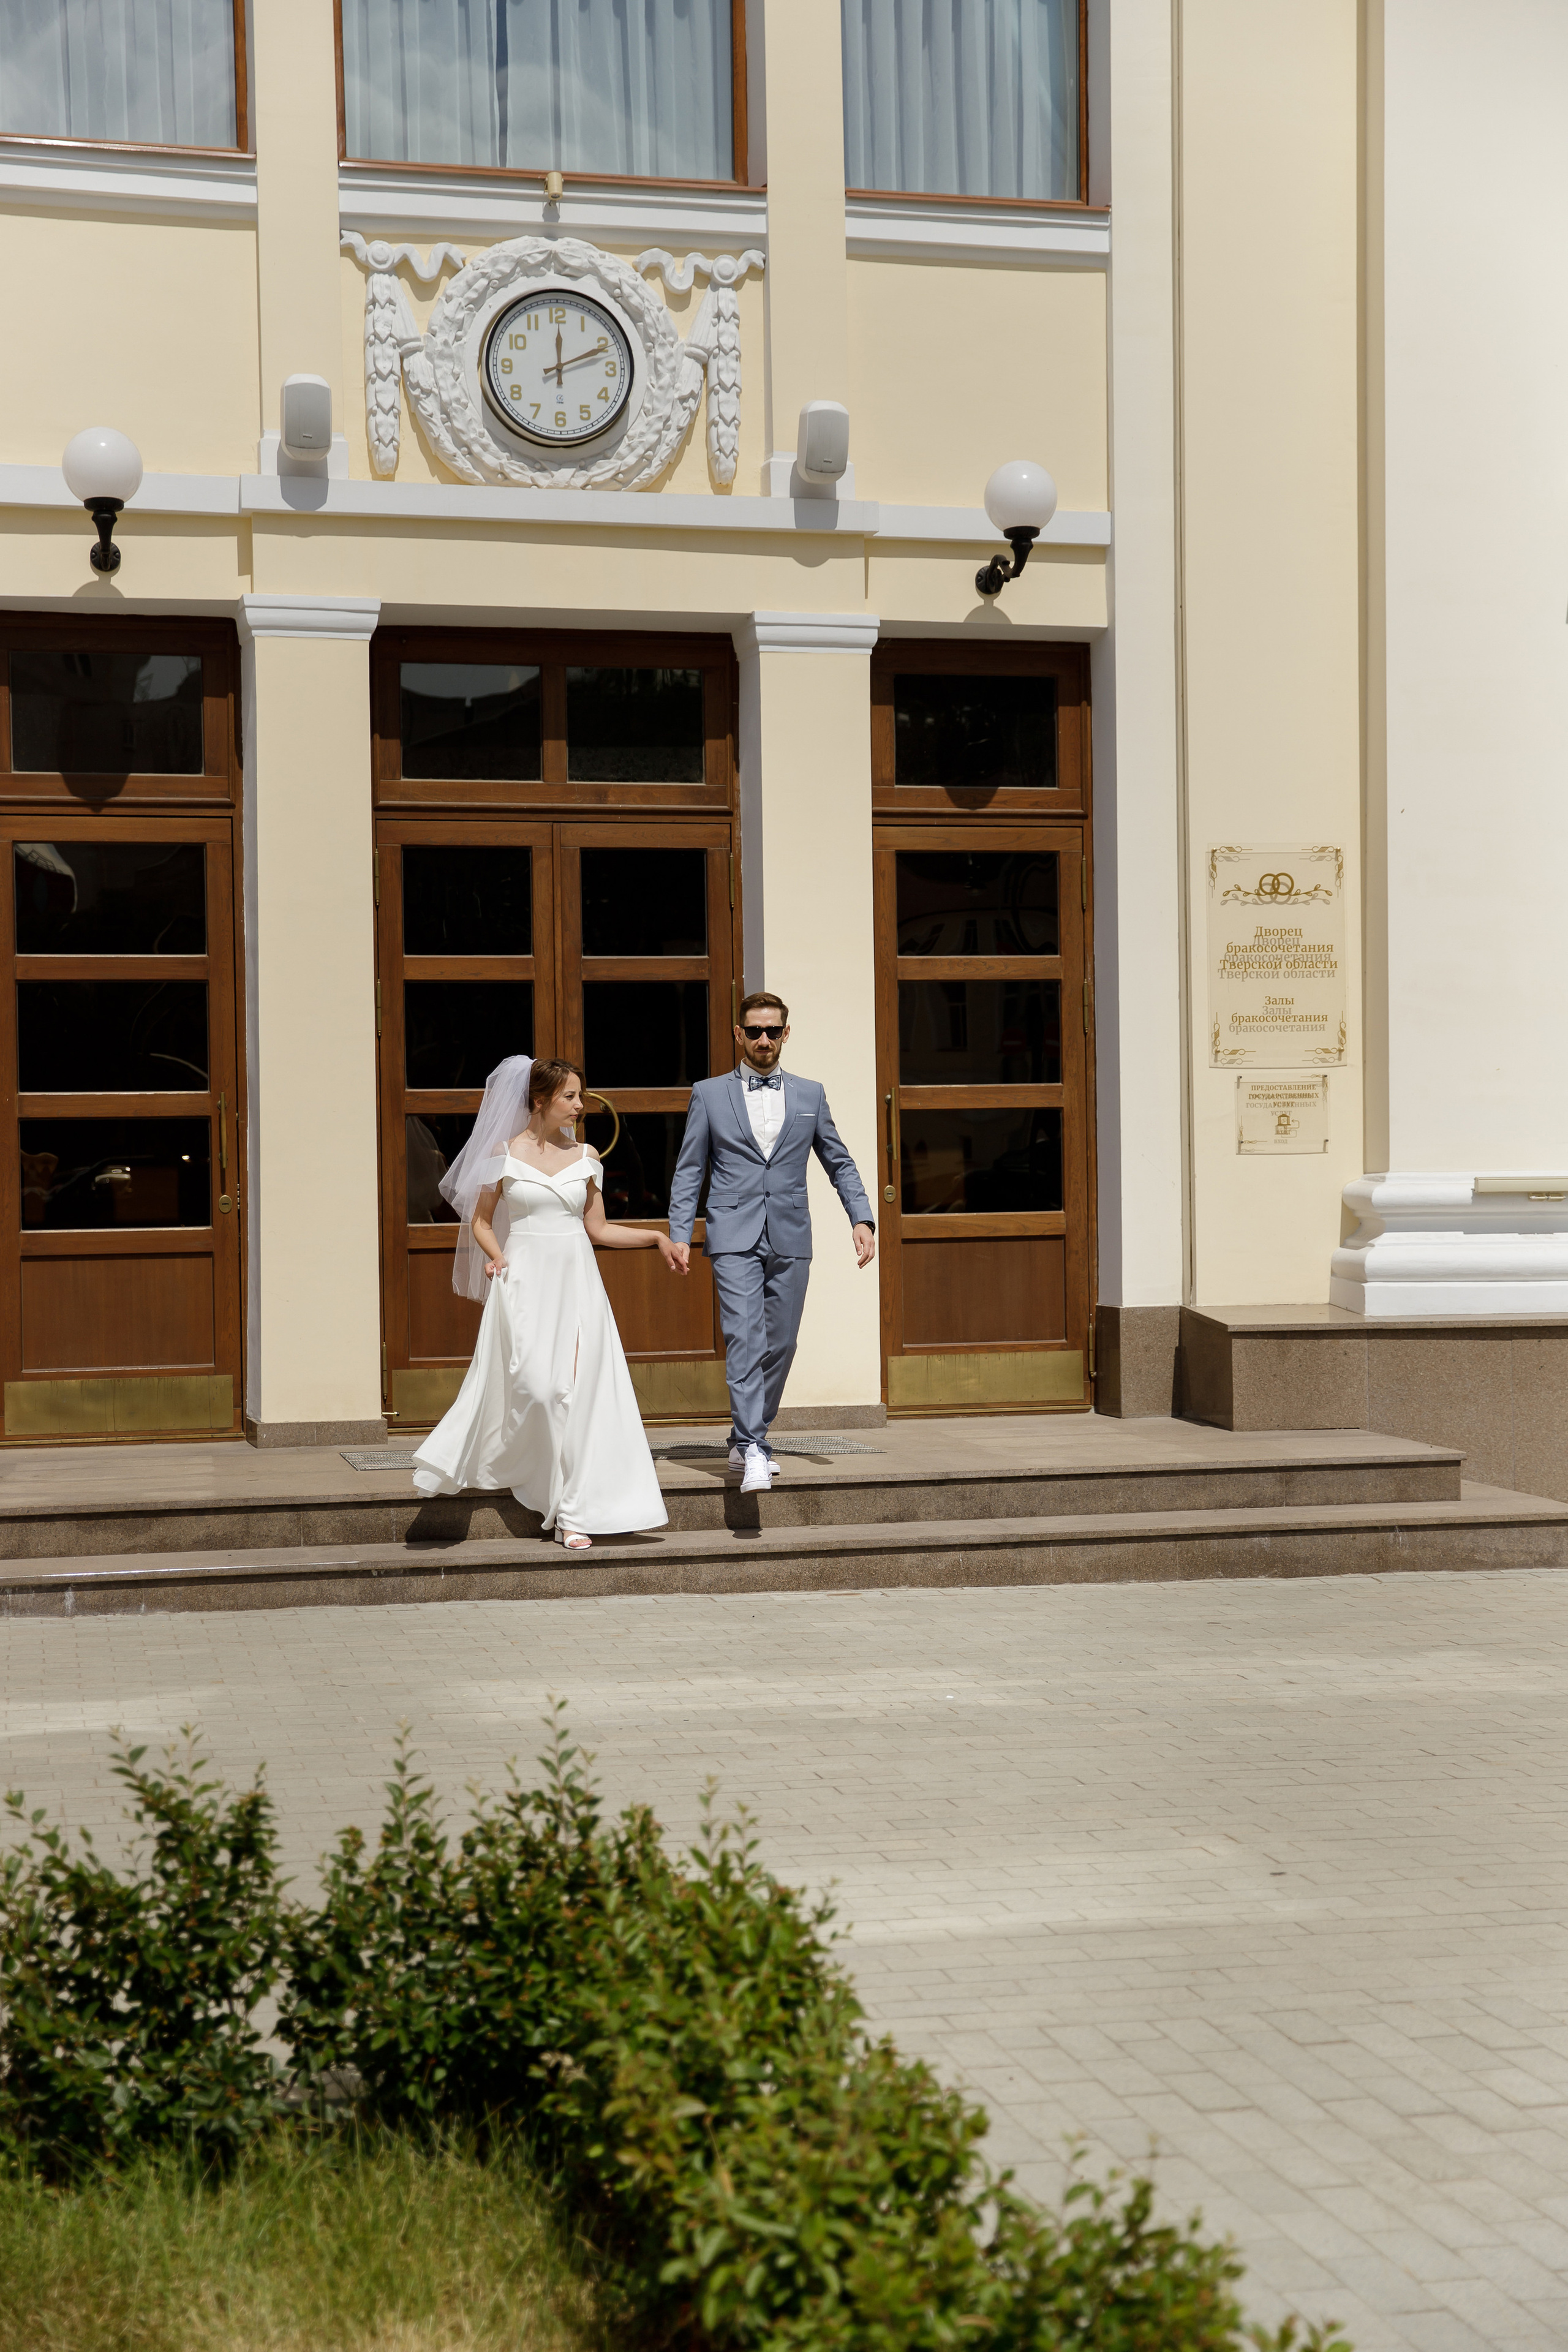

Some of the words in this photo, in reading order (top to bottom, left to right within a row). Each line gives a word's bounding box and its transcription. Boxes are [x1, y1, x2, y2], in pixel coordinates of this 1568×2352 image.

[527, 314, 539, 330] 11
[549, 307, 566, 323] 12
[581, 315, 585, 332] 1
[509, 334, 527, 350] 10
[597, 336, 609, 352] 2
[501, 358, 513, 374] 9
[605, 361, 617, 377] 3
[510, 384, 522, 400] 8
[597, 386, 610, 402] 4
[530, 403, 541, 419] 7
[554, 411, 567, 427] 6
[579, 404, 591, 420] 5
[1255, 926, 1303, 939] Дворец
[1226, 942, 1334, 956] бракосочетания
[1220, 958, 1282, 972] Тверской
[1286, 957, 1338, 969] области
[1265, 996, 1295, 1005] Залы
[1231, 1012, 1328, 1025] бракосочетания
